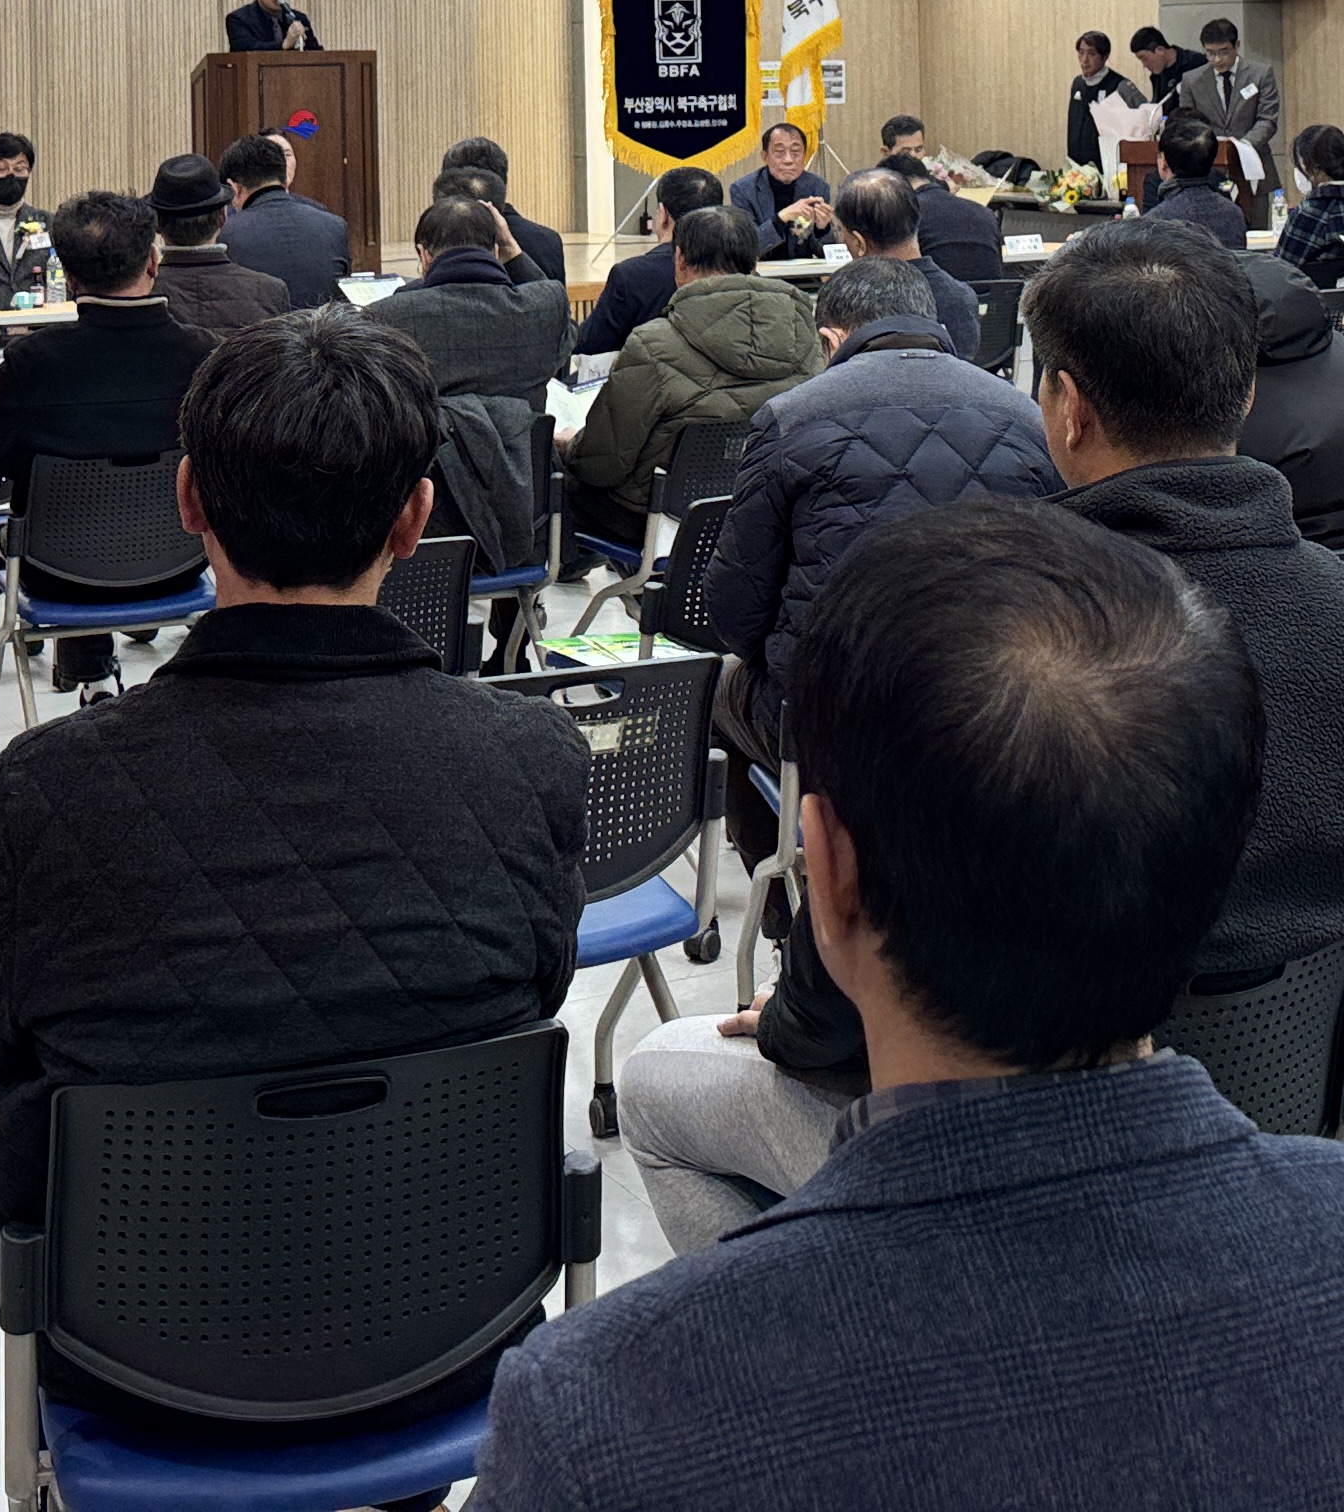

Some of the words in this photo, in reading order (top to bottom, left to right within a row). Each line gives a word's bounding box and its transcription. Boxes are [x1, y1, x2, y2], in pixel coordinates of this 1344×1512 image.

[658, 64, 700, 78] BBFA
[623, 95, 675, 114] 부산광역시
[677, 93, 737, 113] 북구축구협회
